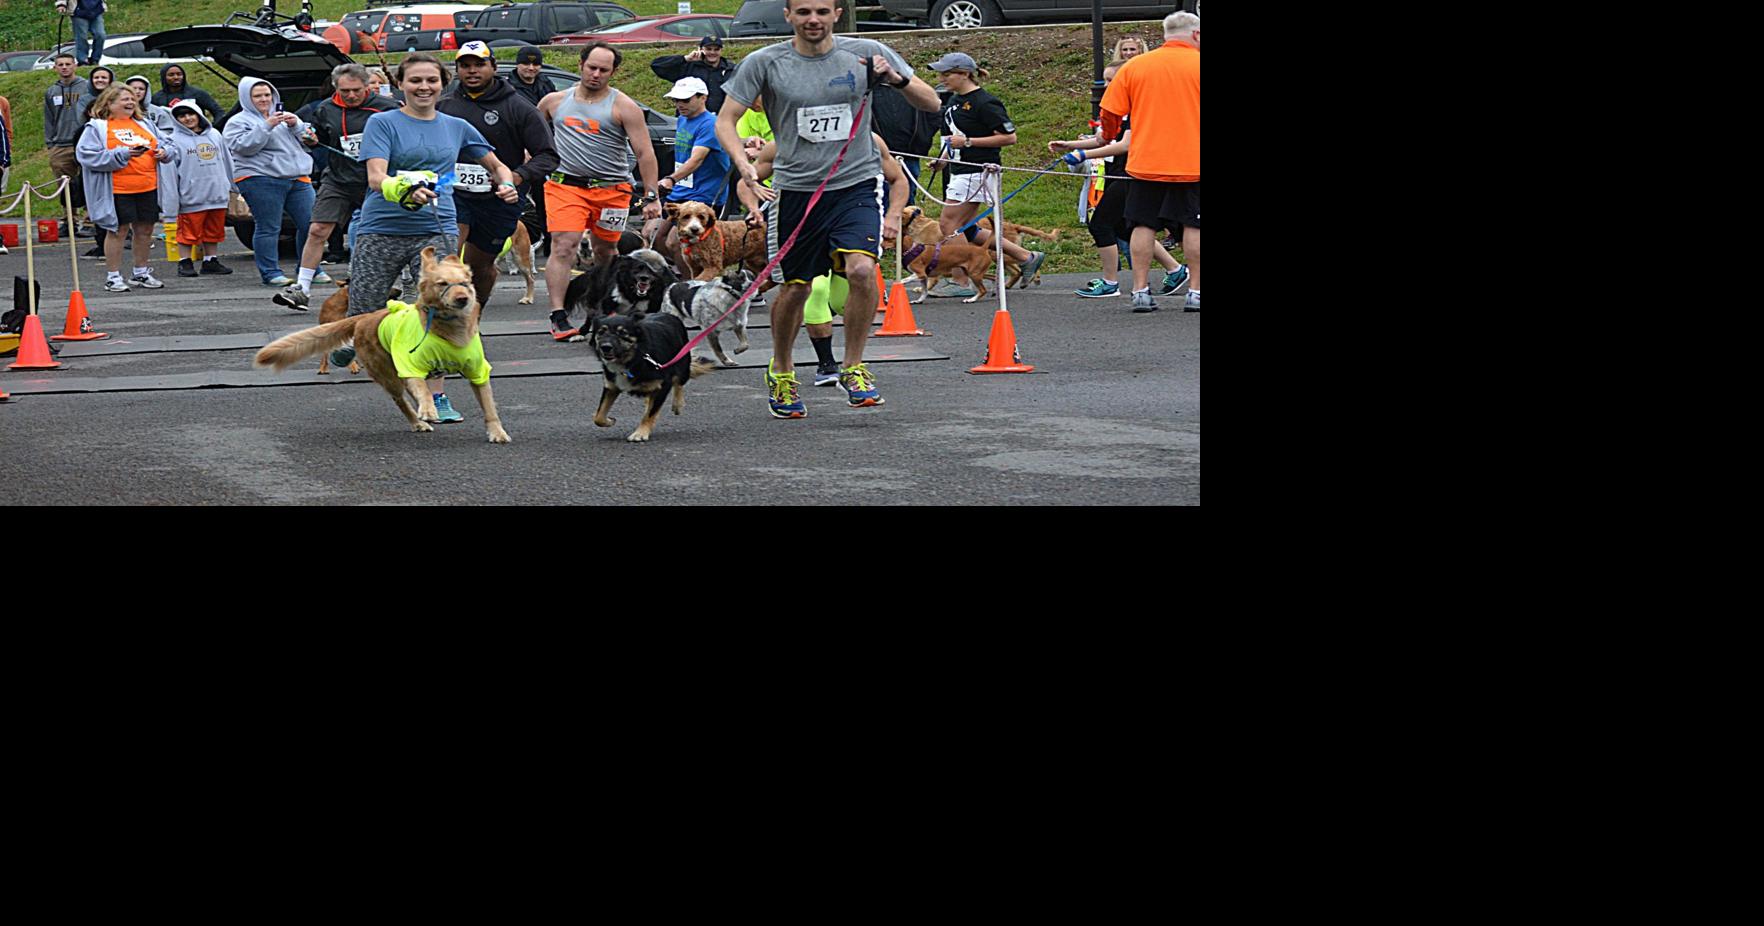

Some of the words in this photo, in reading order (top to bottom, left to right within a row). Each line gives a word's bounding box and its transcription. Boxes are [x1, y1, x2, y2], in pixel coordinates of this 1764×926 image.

[809, 116, 841, 133] 277
[187, 147, 205, 155] Had
[460, 172, 484, 185] 235
